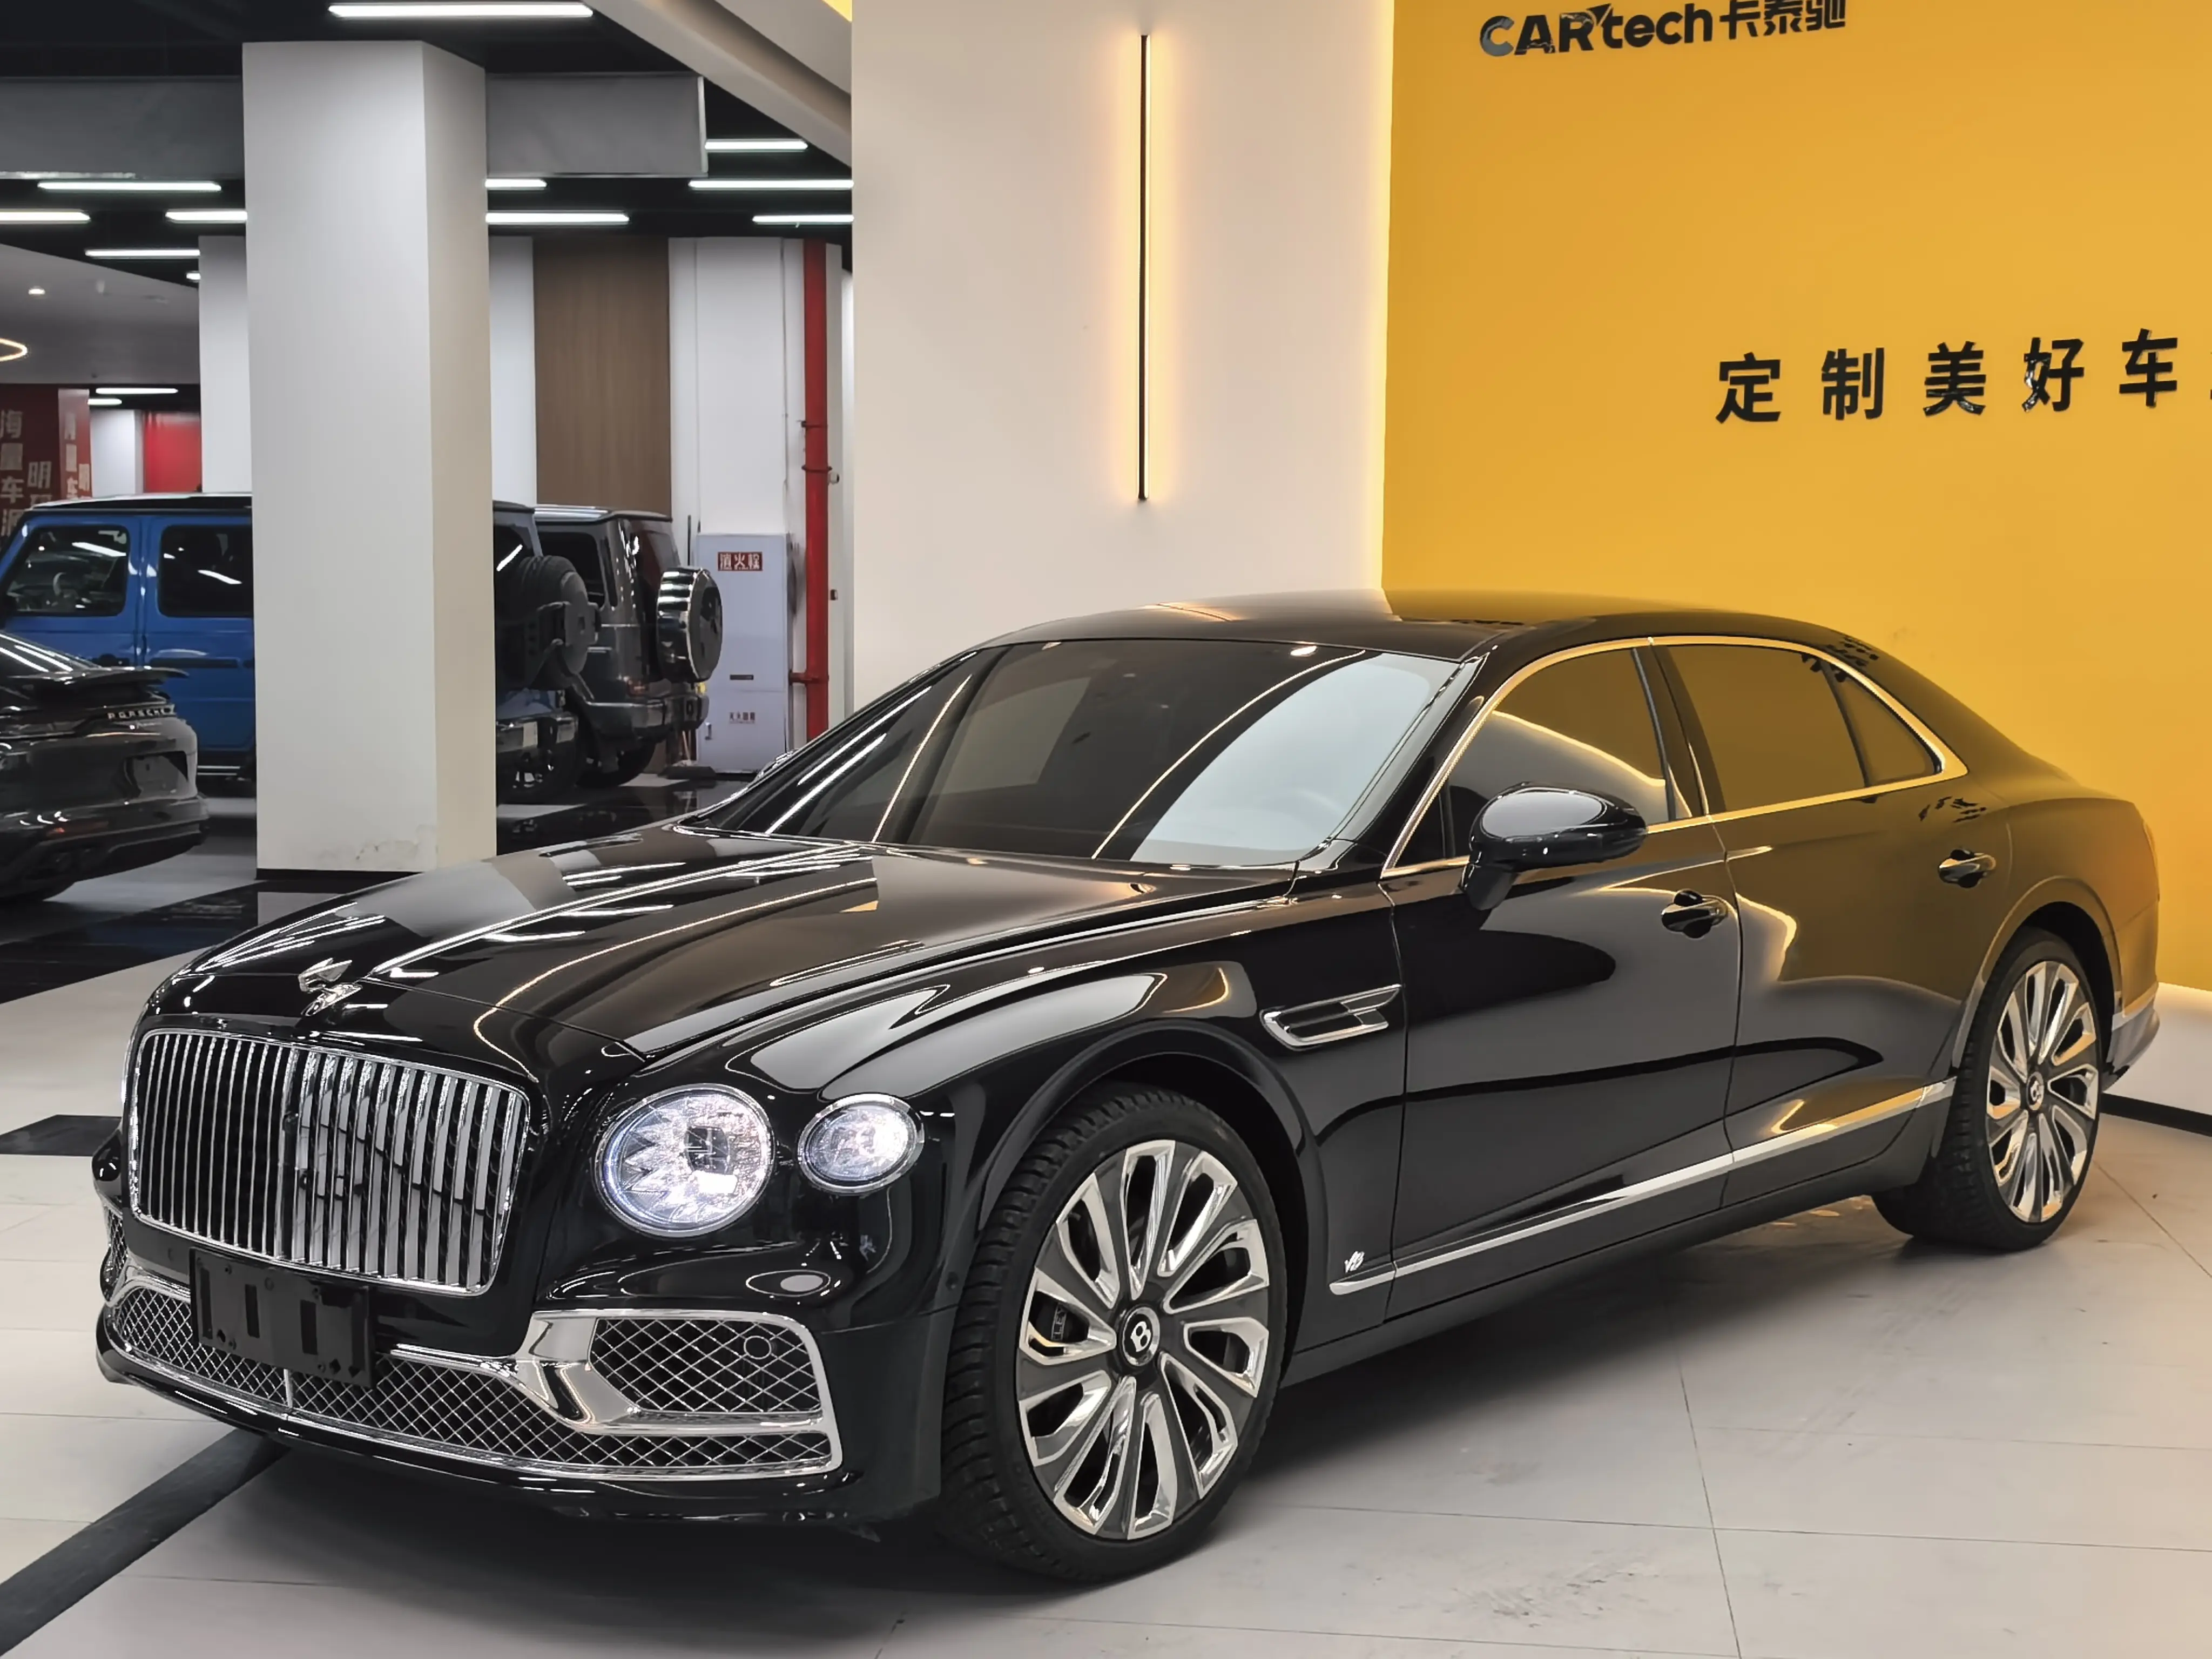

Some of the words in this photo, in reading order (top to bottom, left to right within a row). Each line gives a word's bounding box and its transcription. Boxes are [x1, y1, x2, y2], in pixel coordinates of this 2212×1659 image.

[1479, 3, 1713, 57] CARtech
[1715, 328, 2212, 424] 定制美好车
